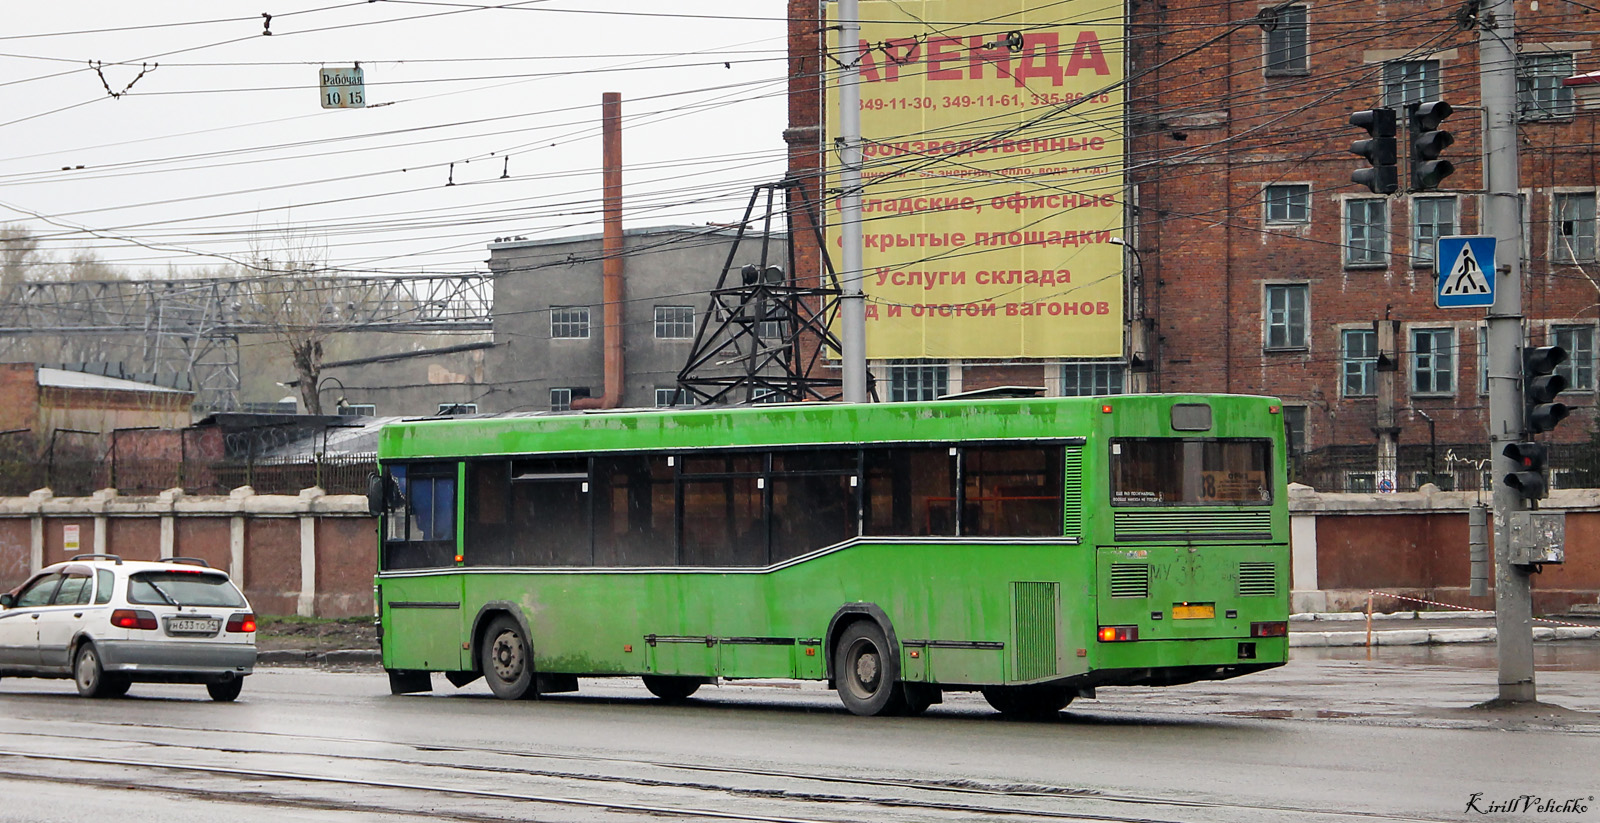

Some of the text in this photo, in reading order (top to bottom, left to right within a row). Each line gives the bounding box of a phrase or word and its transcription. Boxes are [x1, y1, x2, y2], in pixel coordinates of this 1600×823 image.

[837, 31, 1110, 88] АРЕНДА
[323, 73, 363, 85] Рабочая
[942, 94, 1025, 109] 349-11-61,
[1031, 92, 1110, 105] 335-8626
[862, 136, 1105, 162] роизводственные
[1039, 166, 1068, 175] вода
[990, 191, 1115, 213] офисные
[837, 230, 1111, 252] крытые площадки
[876, 267, 1071, 290] Услуги склада
[888, 304, 902, 317] и
[911, 299, 996, 317] отстой
[1006, 301, 1110, 316] вагонов
